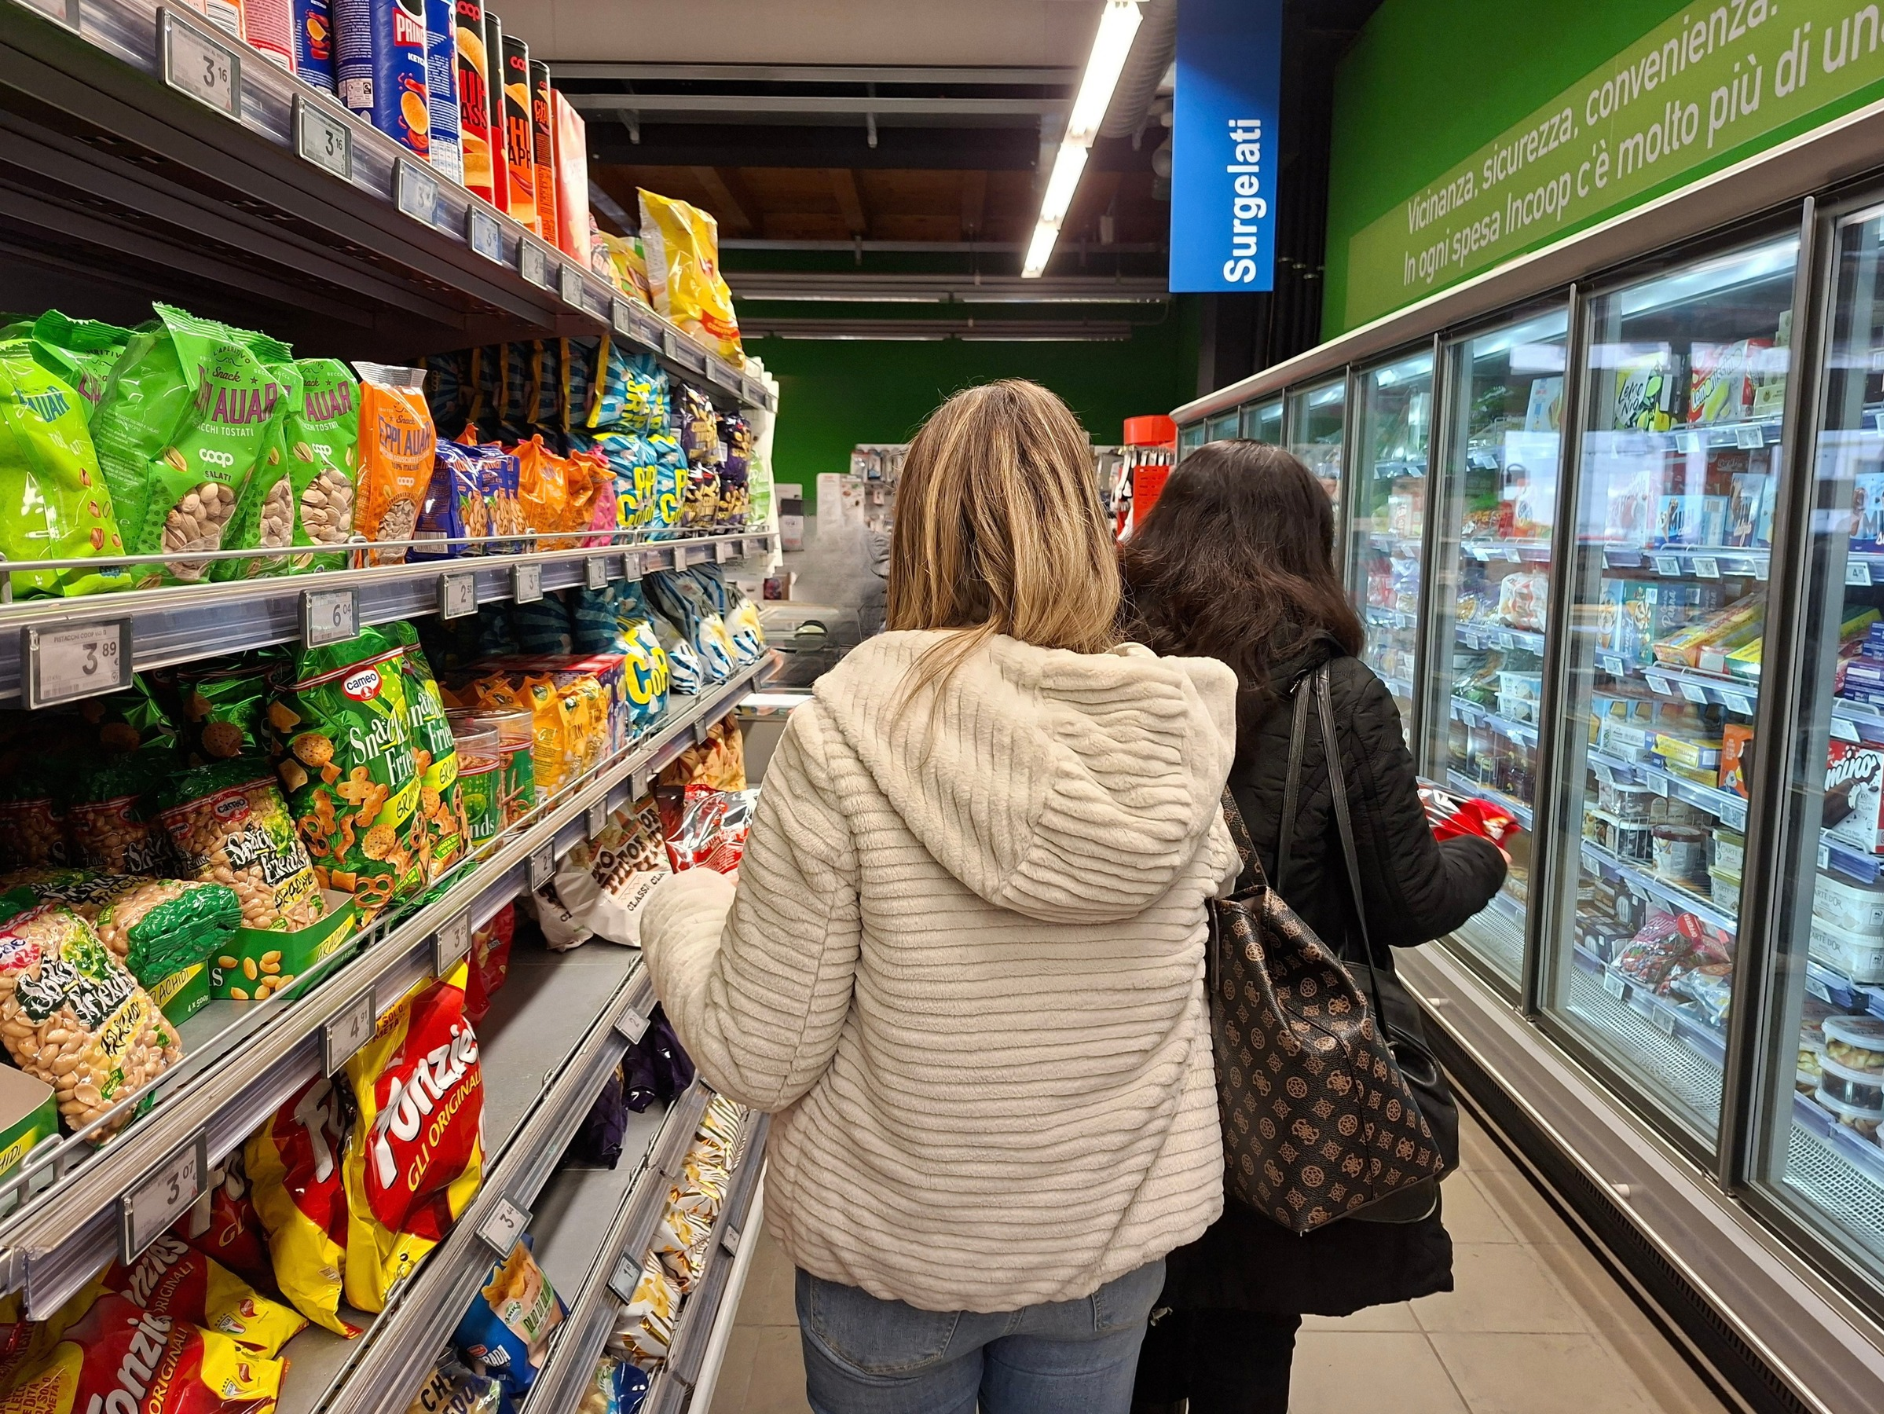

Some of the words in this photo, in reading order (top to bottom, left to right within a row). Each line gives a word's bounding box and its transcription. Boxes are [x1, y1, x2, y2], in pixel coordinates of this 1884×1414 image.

[202, 56, 215, 88] 3
[218, 67, 228, 83] 16
[1408, 171, 1478, 234] Vicinanza,
[1482, 107, 1579, 190] sicurezza,
[1586, 0, 1778, 126] convenienza.
[325, 130, 334, 156] 3
[336, 138, 342, 151] 16
[1404, 250, 1416, 286] In
[1419, 228, 1450, 284] ogni
[1452, 210, 1501, 268] spesa
[1505, 172, 1571, 235] Incoop
[1577, 139, 1609, 198] c'è
[1617, 100, 1699, 180] molto
[1707, 53, 1763, 149] più
[1774, 21, 1811, 98] di
[1822, 4, 1884, 74] un
[1223, 119, 1267, 283] Surgelati
[212, 366, 241, 383] Snack
[305, 380, 353, 422] AUAR
[221, 426, 254, 437] TOSTATI
[199, 448, 234, 468] coop
[204, 470, 232, 482] SALATI
[396, 476, 415, 488] coop
[460, 584, 466, 603] 2
[332, 604, 341, 626] 6
[80, 631, 94, 640] COOP
[82, 643, 98, 675] 3
[102, 641, 117, 657] 89
[346, 672, 377, 690] cameo
[350, 708, 409, 765] Snack
[543, 855, 547, 871] 2
[454, 928, 460, 948] 3
[350, 1016, 360, 1039] 4
[167, 1172, 180, 1205] 3
[182, 1161, 194, 1178] 07
[407, 1155, 430, 1192] GLI
[500, 1216, 514, 1229] 3
